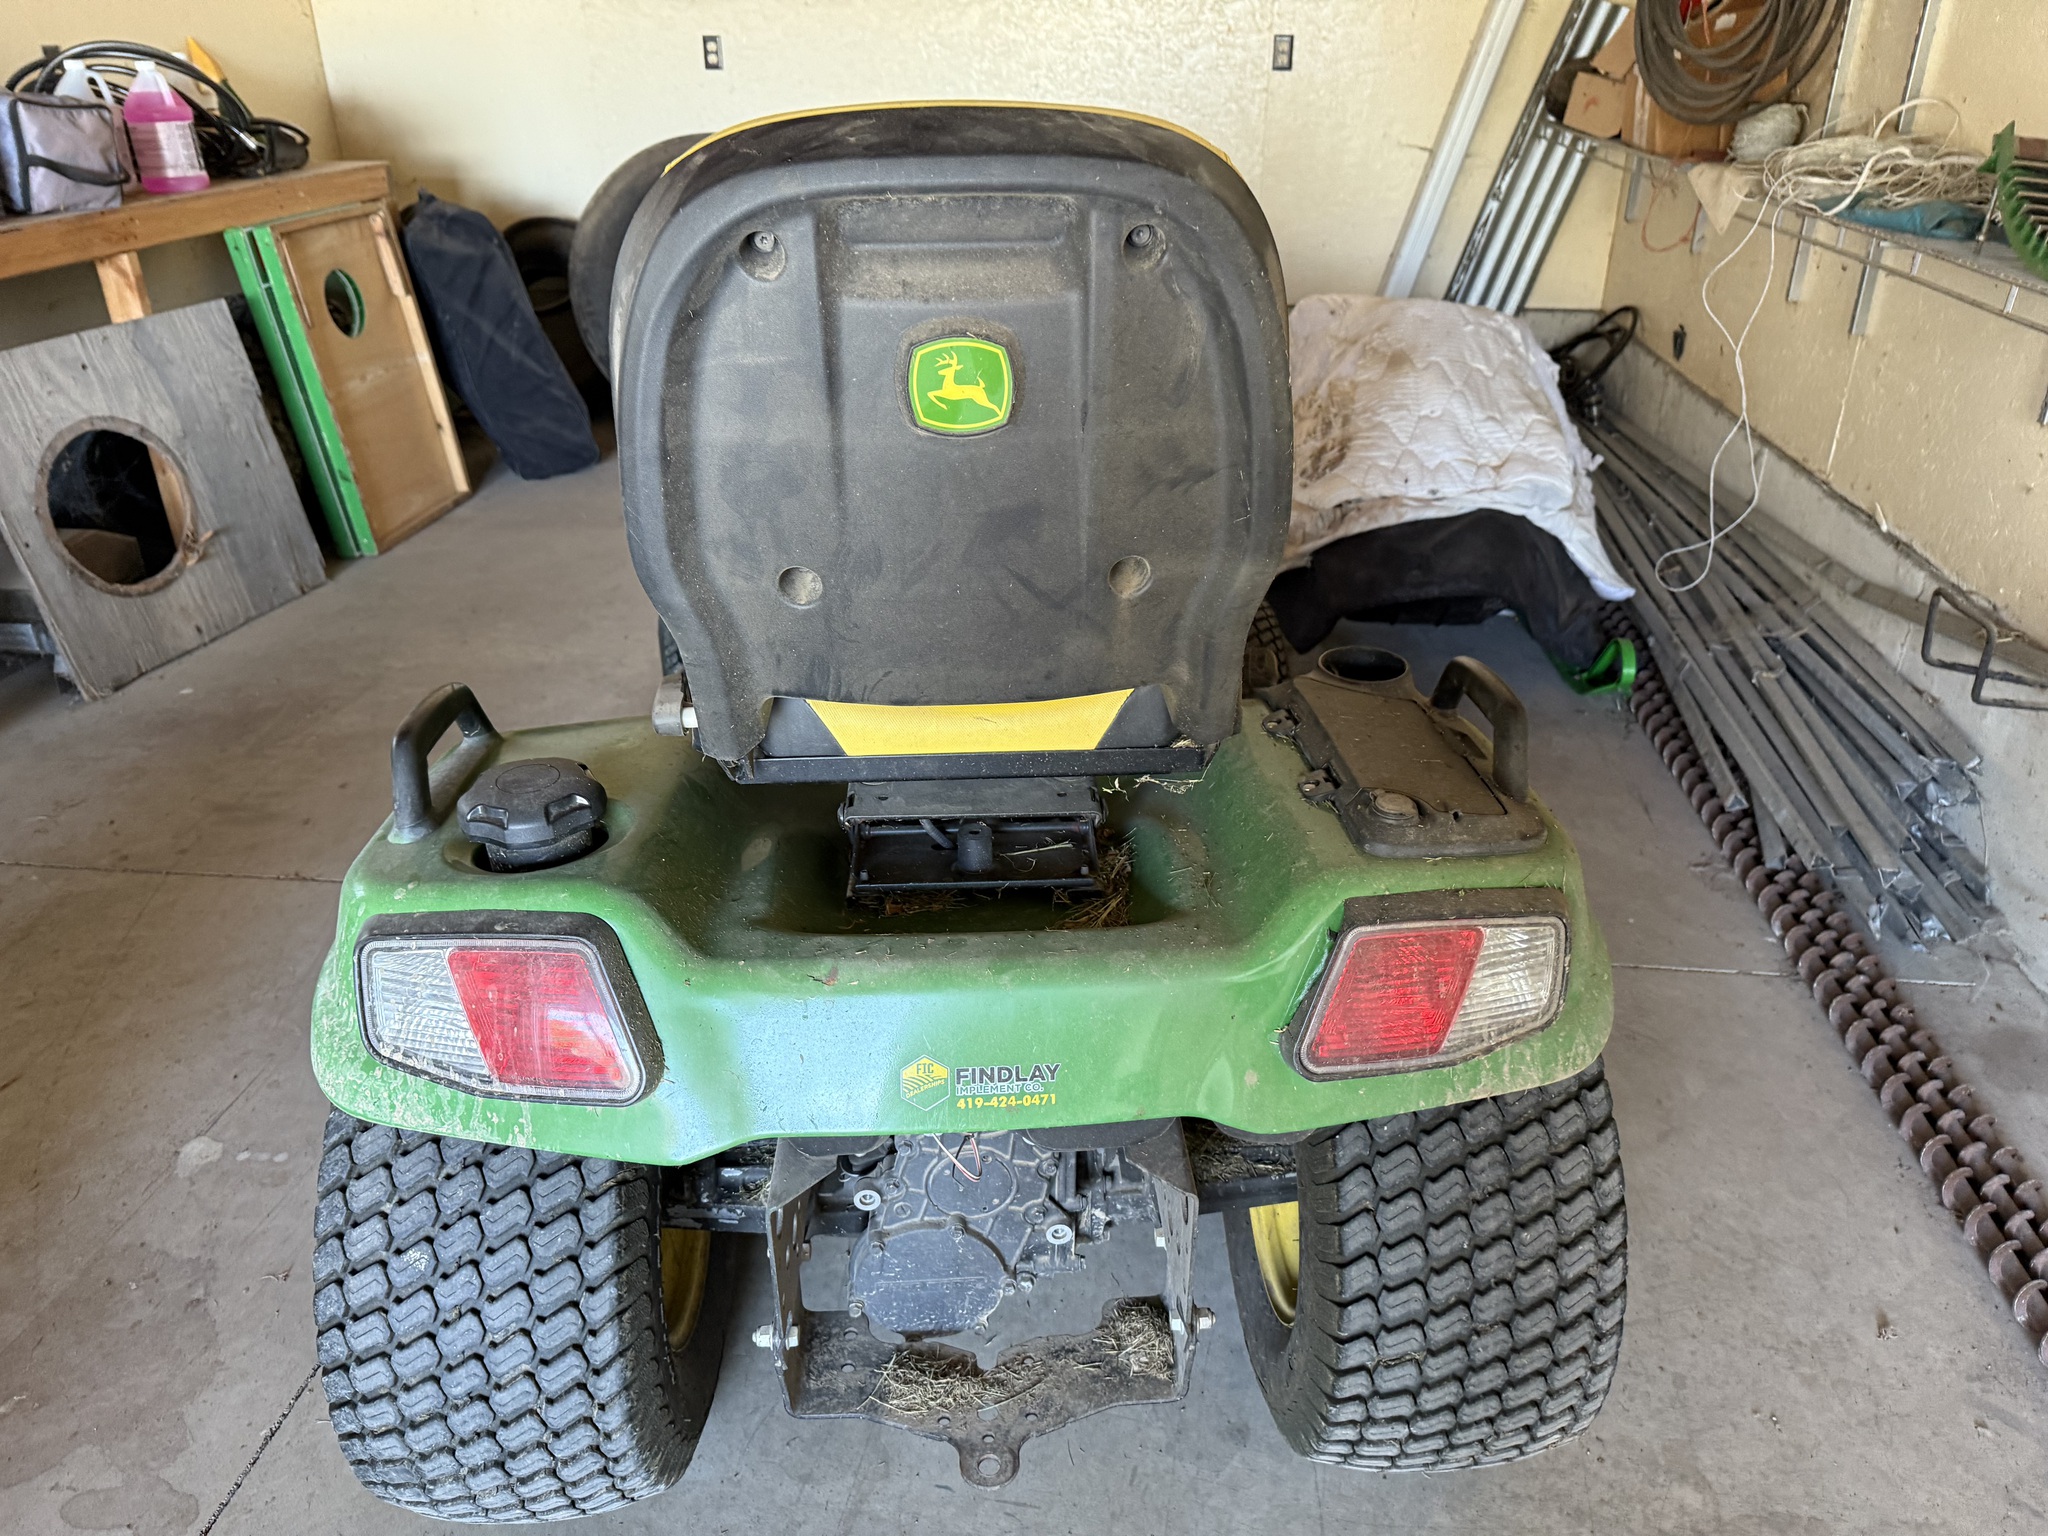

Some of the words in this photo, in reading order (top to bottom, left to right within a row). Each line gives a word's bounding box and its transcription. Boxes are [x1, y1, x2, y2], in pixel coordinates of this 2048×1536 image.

[916, 1063, 934, 1074] FIC
[956, 1064, 1060, 1084] FINDLAY
[956, 1084, 1021, 1095] IMPLEMENT
[1025, 1083, 1044, 1092] CO.
[957, 1094, 1056, 1109] 419-424-0471
